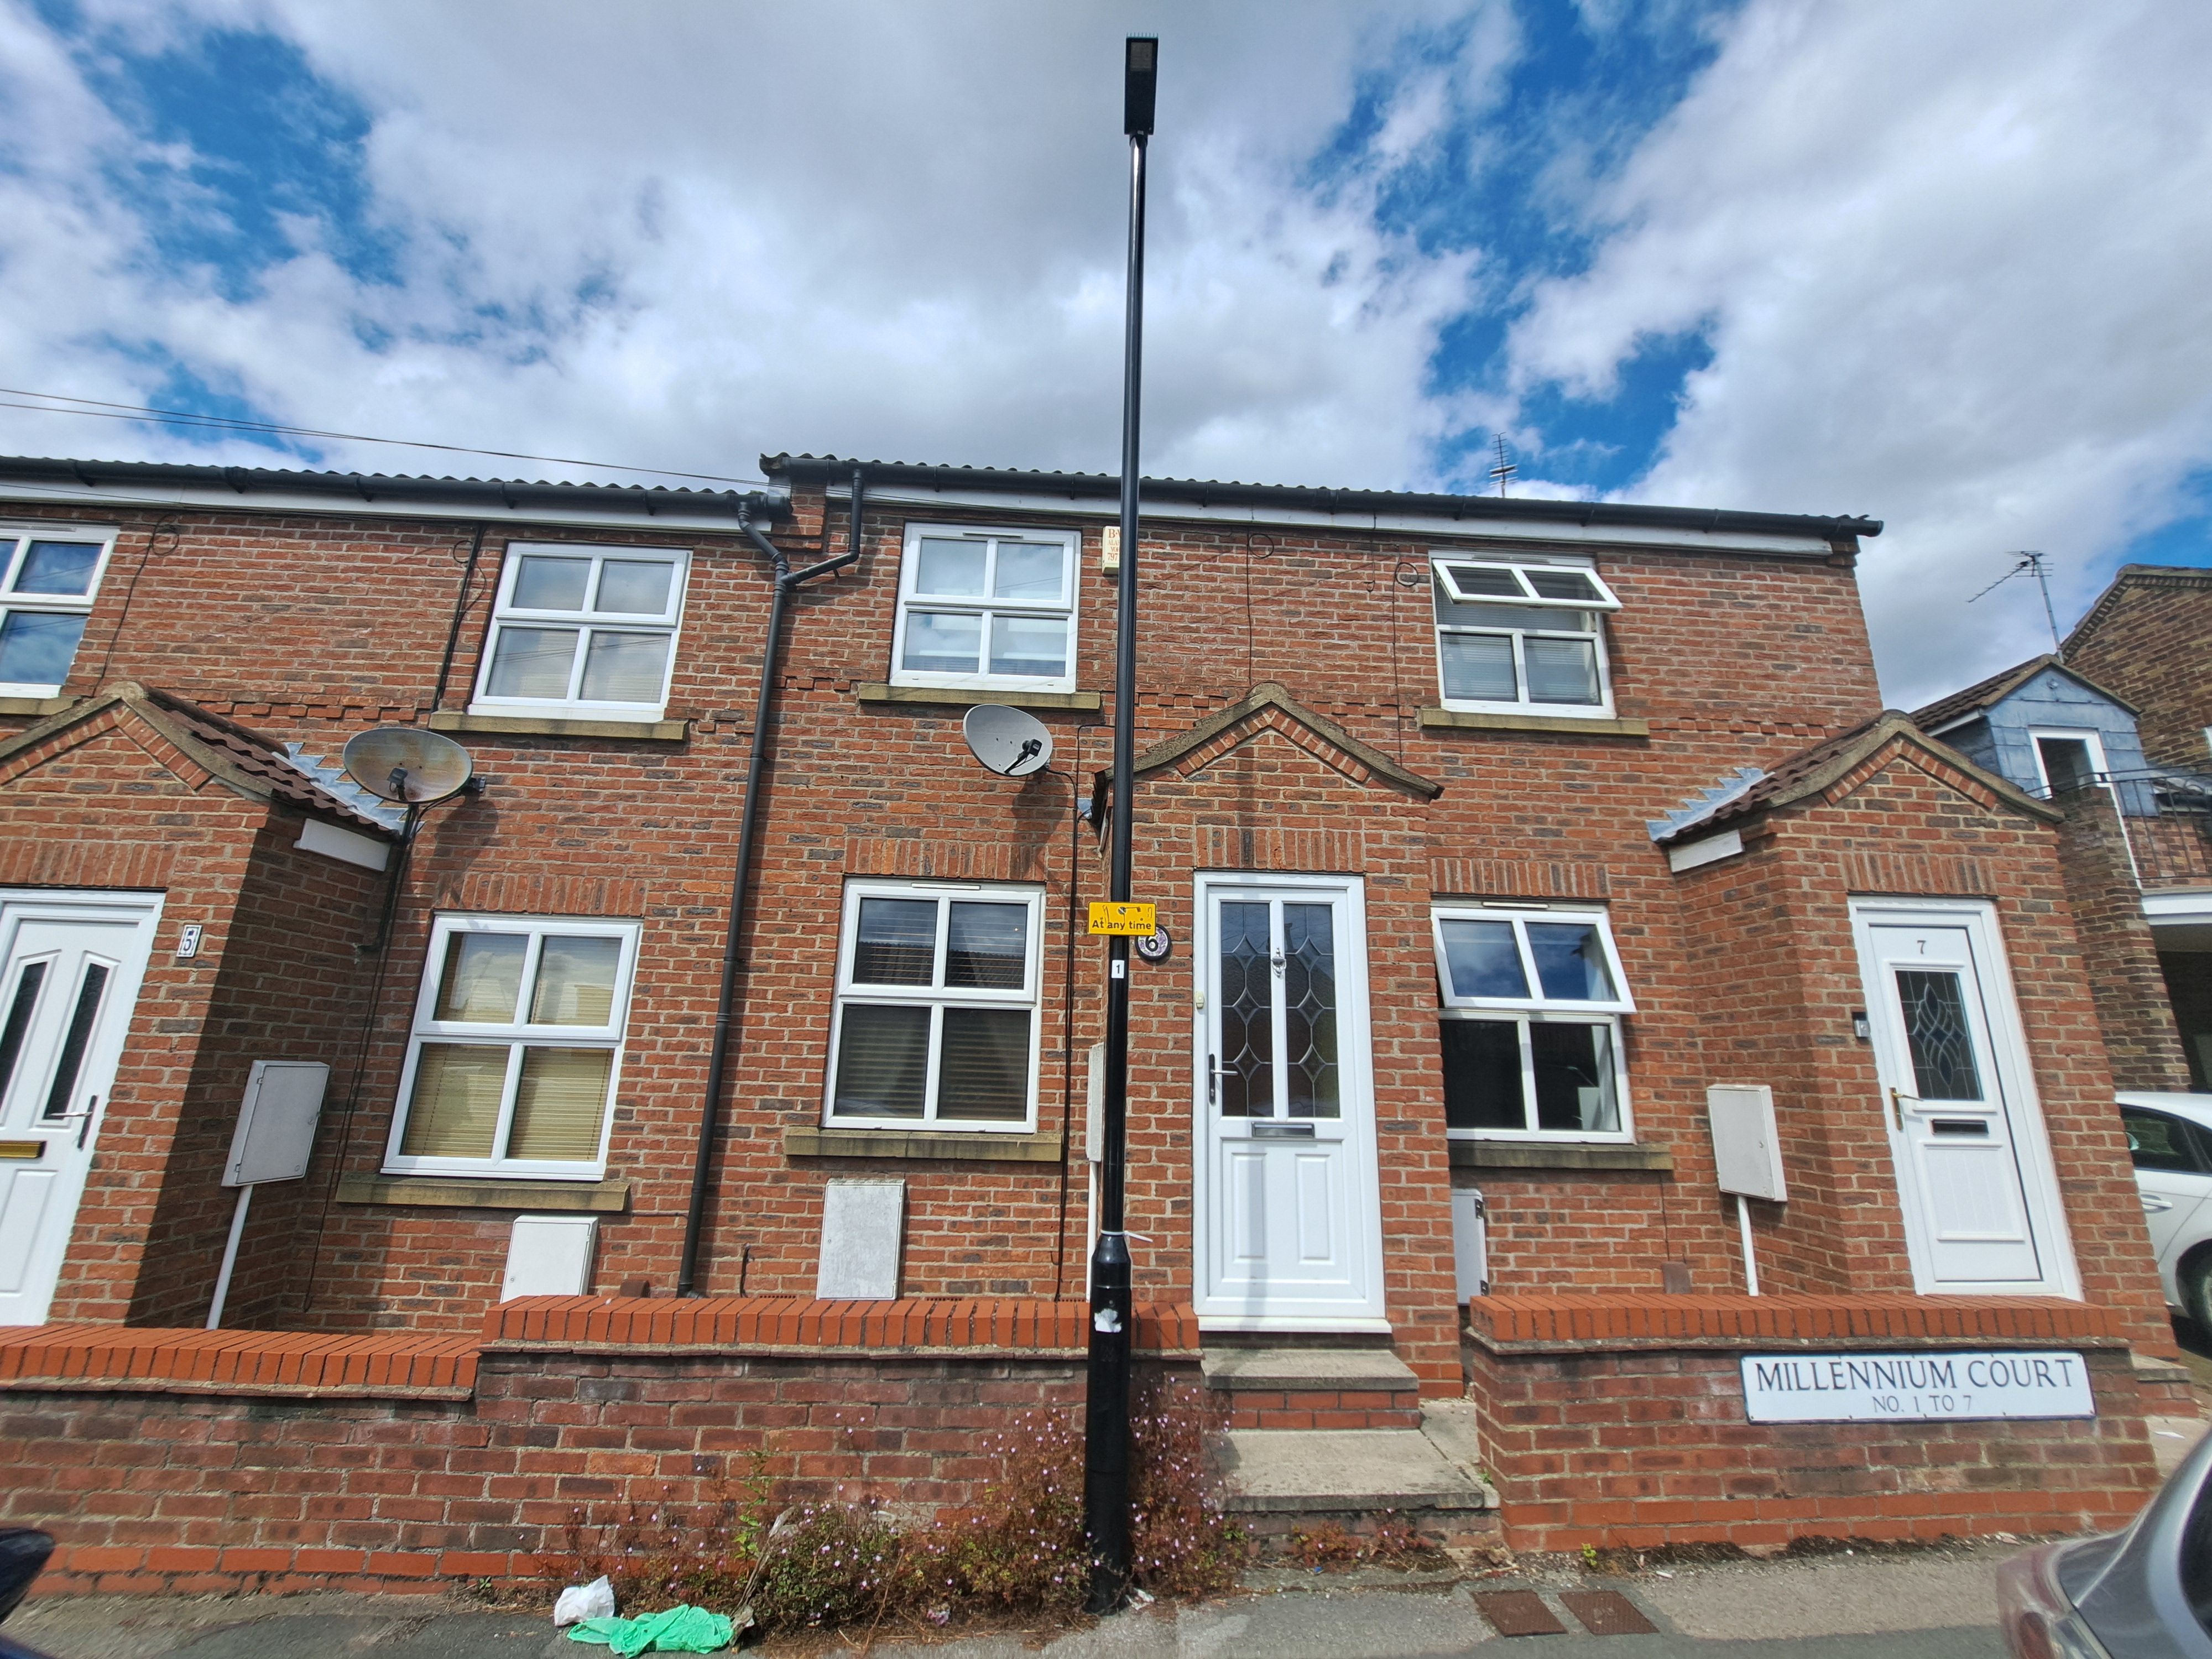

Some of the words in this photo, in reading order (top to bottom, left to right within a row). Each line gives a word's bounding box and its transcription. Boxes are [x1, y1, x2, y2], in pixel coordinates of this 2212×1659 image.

[1092, 920, 1104, 928] At
[1107, 922, 1125, 931] any
[1129, 921, 1151, 930] time
[183, 930, 195, 952] 5
[1145, 932, 1159, 952] 6
[1917, 940, 1926, 955] 7
[1116, 964, 1120, 974] 1
[1755, 1360, 1958, 1391] MILLENNIUM
[1968, 1359, 2073, 1388] COURT
[1872, 1395, 1905, 1413] NO.
[1928, 1394, 1954, 1412] TO
[1963, 1395, 1971, 1411] 7
